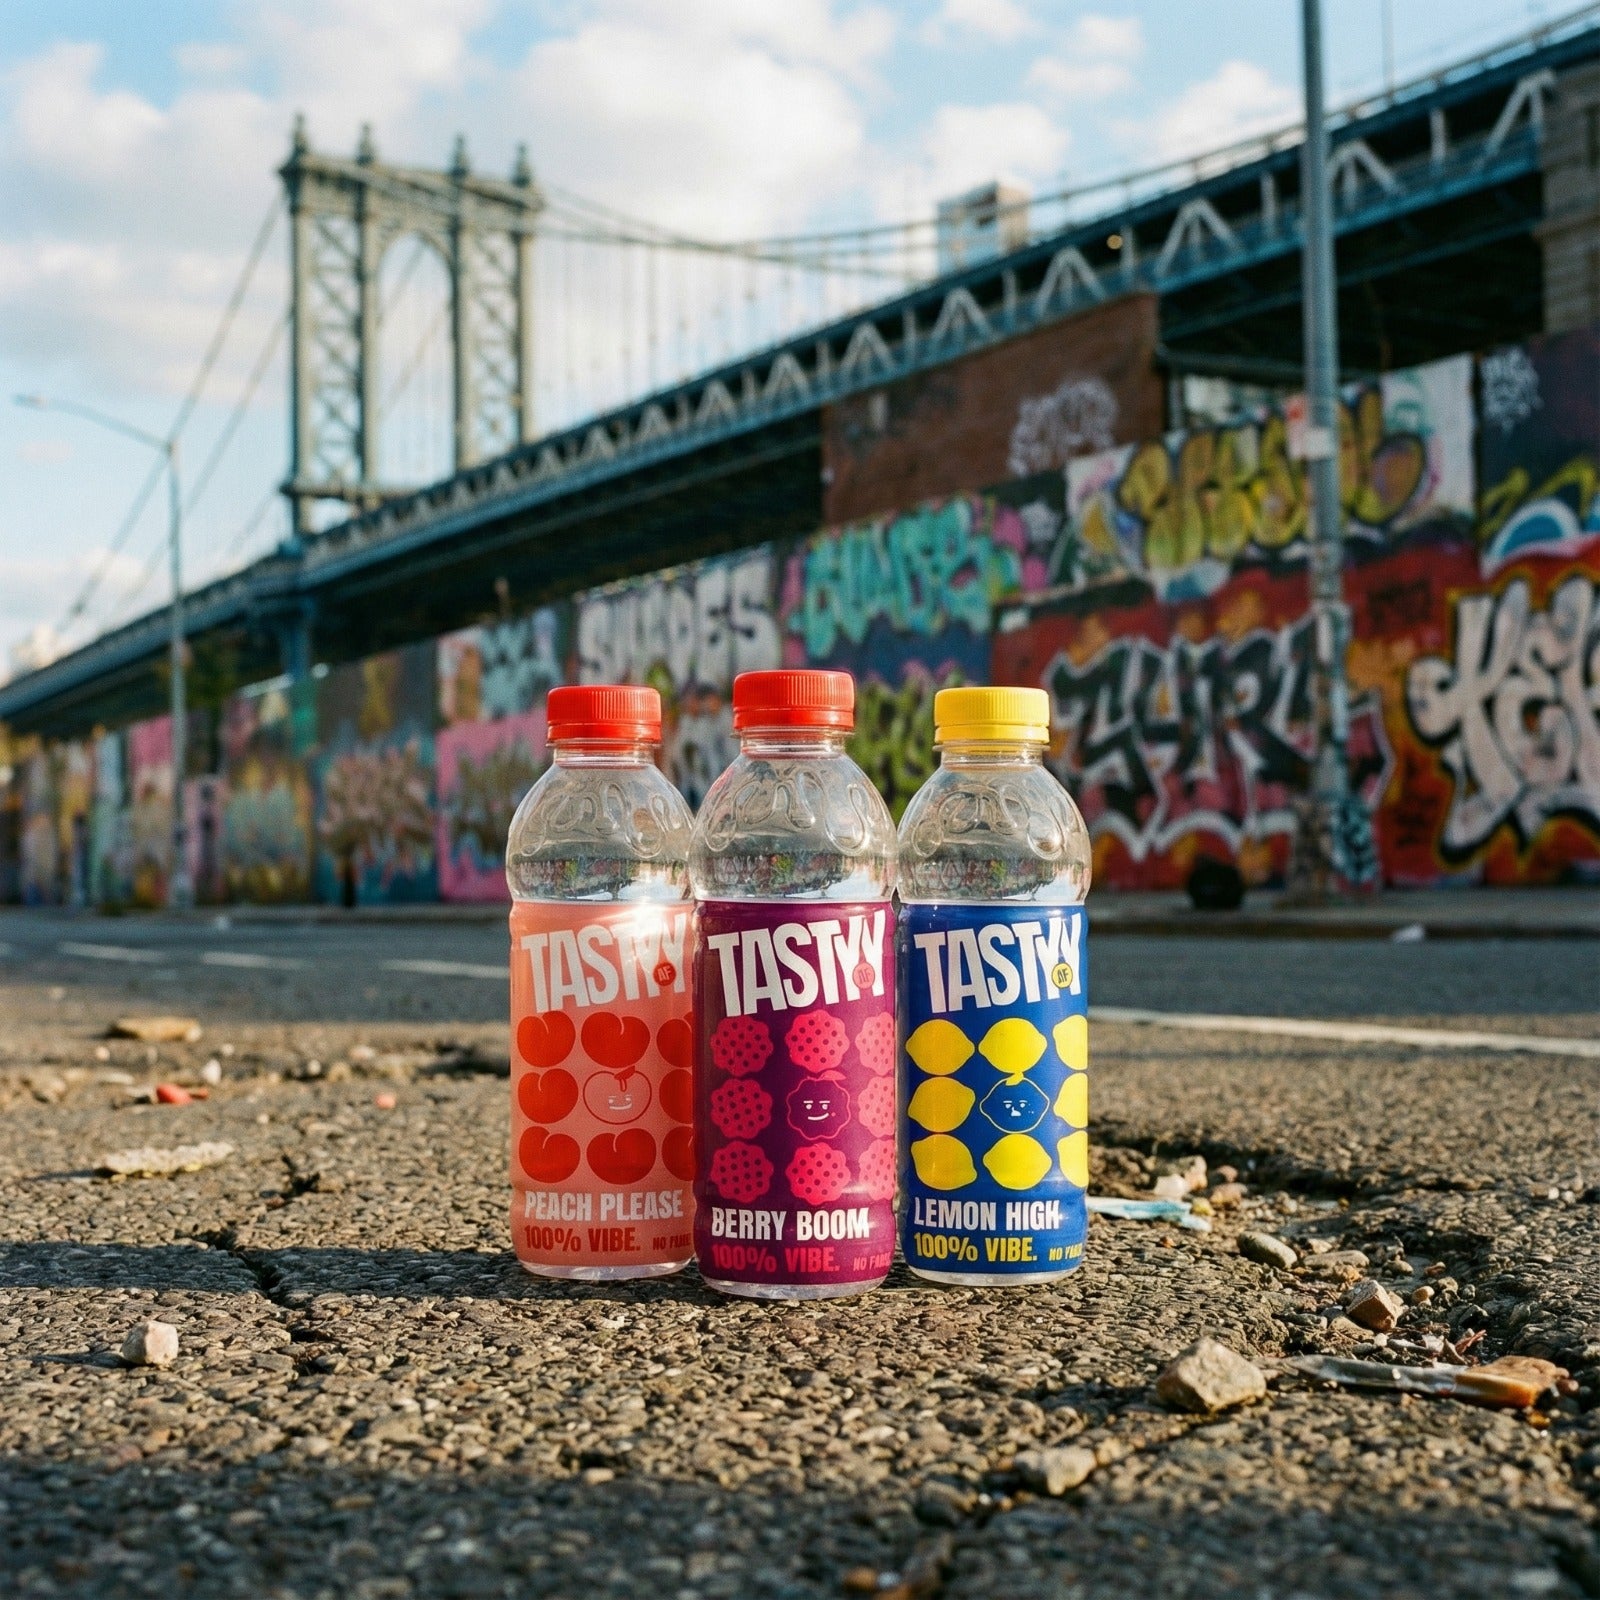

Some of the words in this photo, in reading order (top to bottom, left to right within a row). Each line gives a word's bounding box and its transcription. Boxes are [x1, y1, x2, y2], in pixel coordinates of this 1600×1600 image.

[657, 966, 672, 982] AF
[1056, 969, 1070, 984] AF
[524, 1190, 593, 1221] PEACH
[600, 1189, 684, 1221] PLEASE
[913, 1196, 997, 1231] LEMON
[1006, 1199, 1060, 1231] HIGH
[524, 1225, 582, 1252] 100%
[588, 1227, 641, 1252] VIBE.
[711, 1206, 787, 1241] BERRY
[796, 1207, 870, 1241] BOOM
[712, 1243, 778, 1273] 100%
[785, 1246, 841, 1273] VIBE.
[853, 1256, 867, 1271] NO
[913, 1232, 979, 1262] 100%
[985, 1237, 1038, 1262] VIBE.
